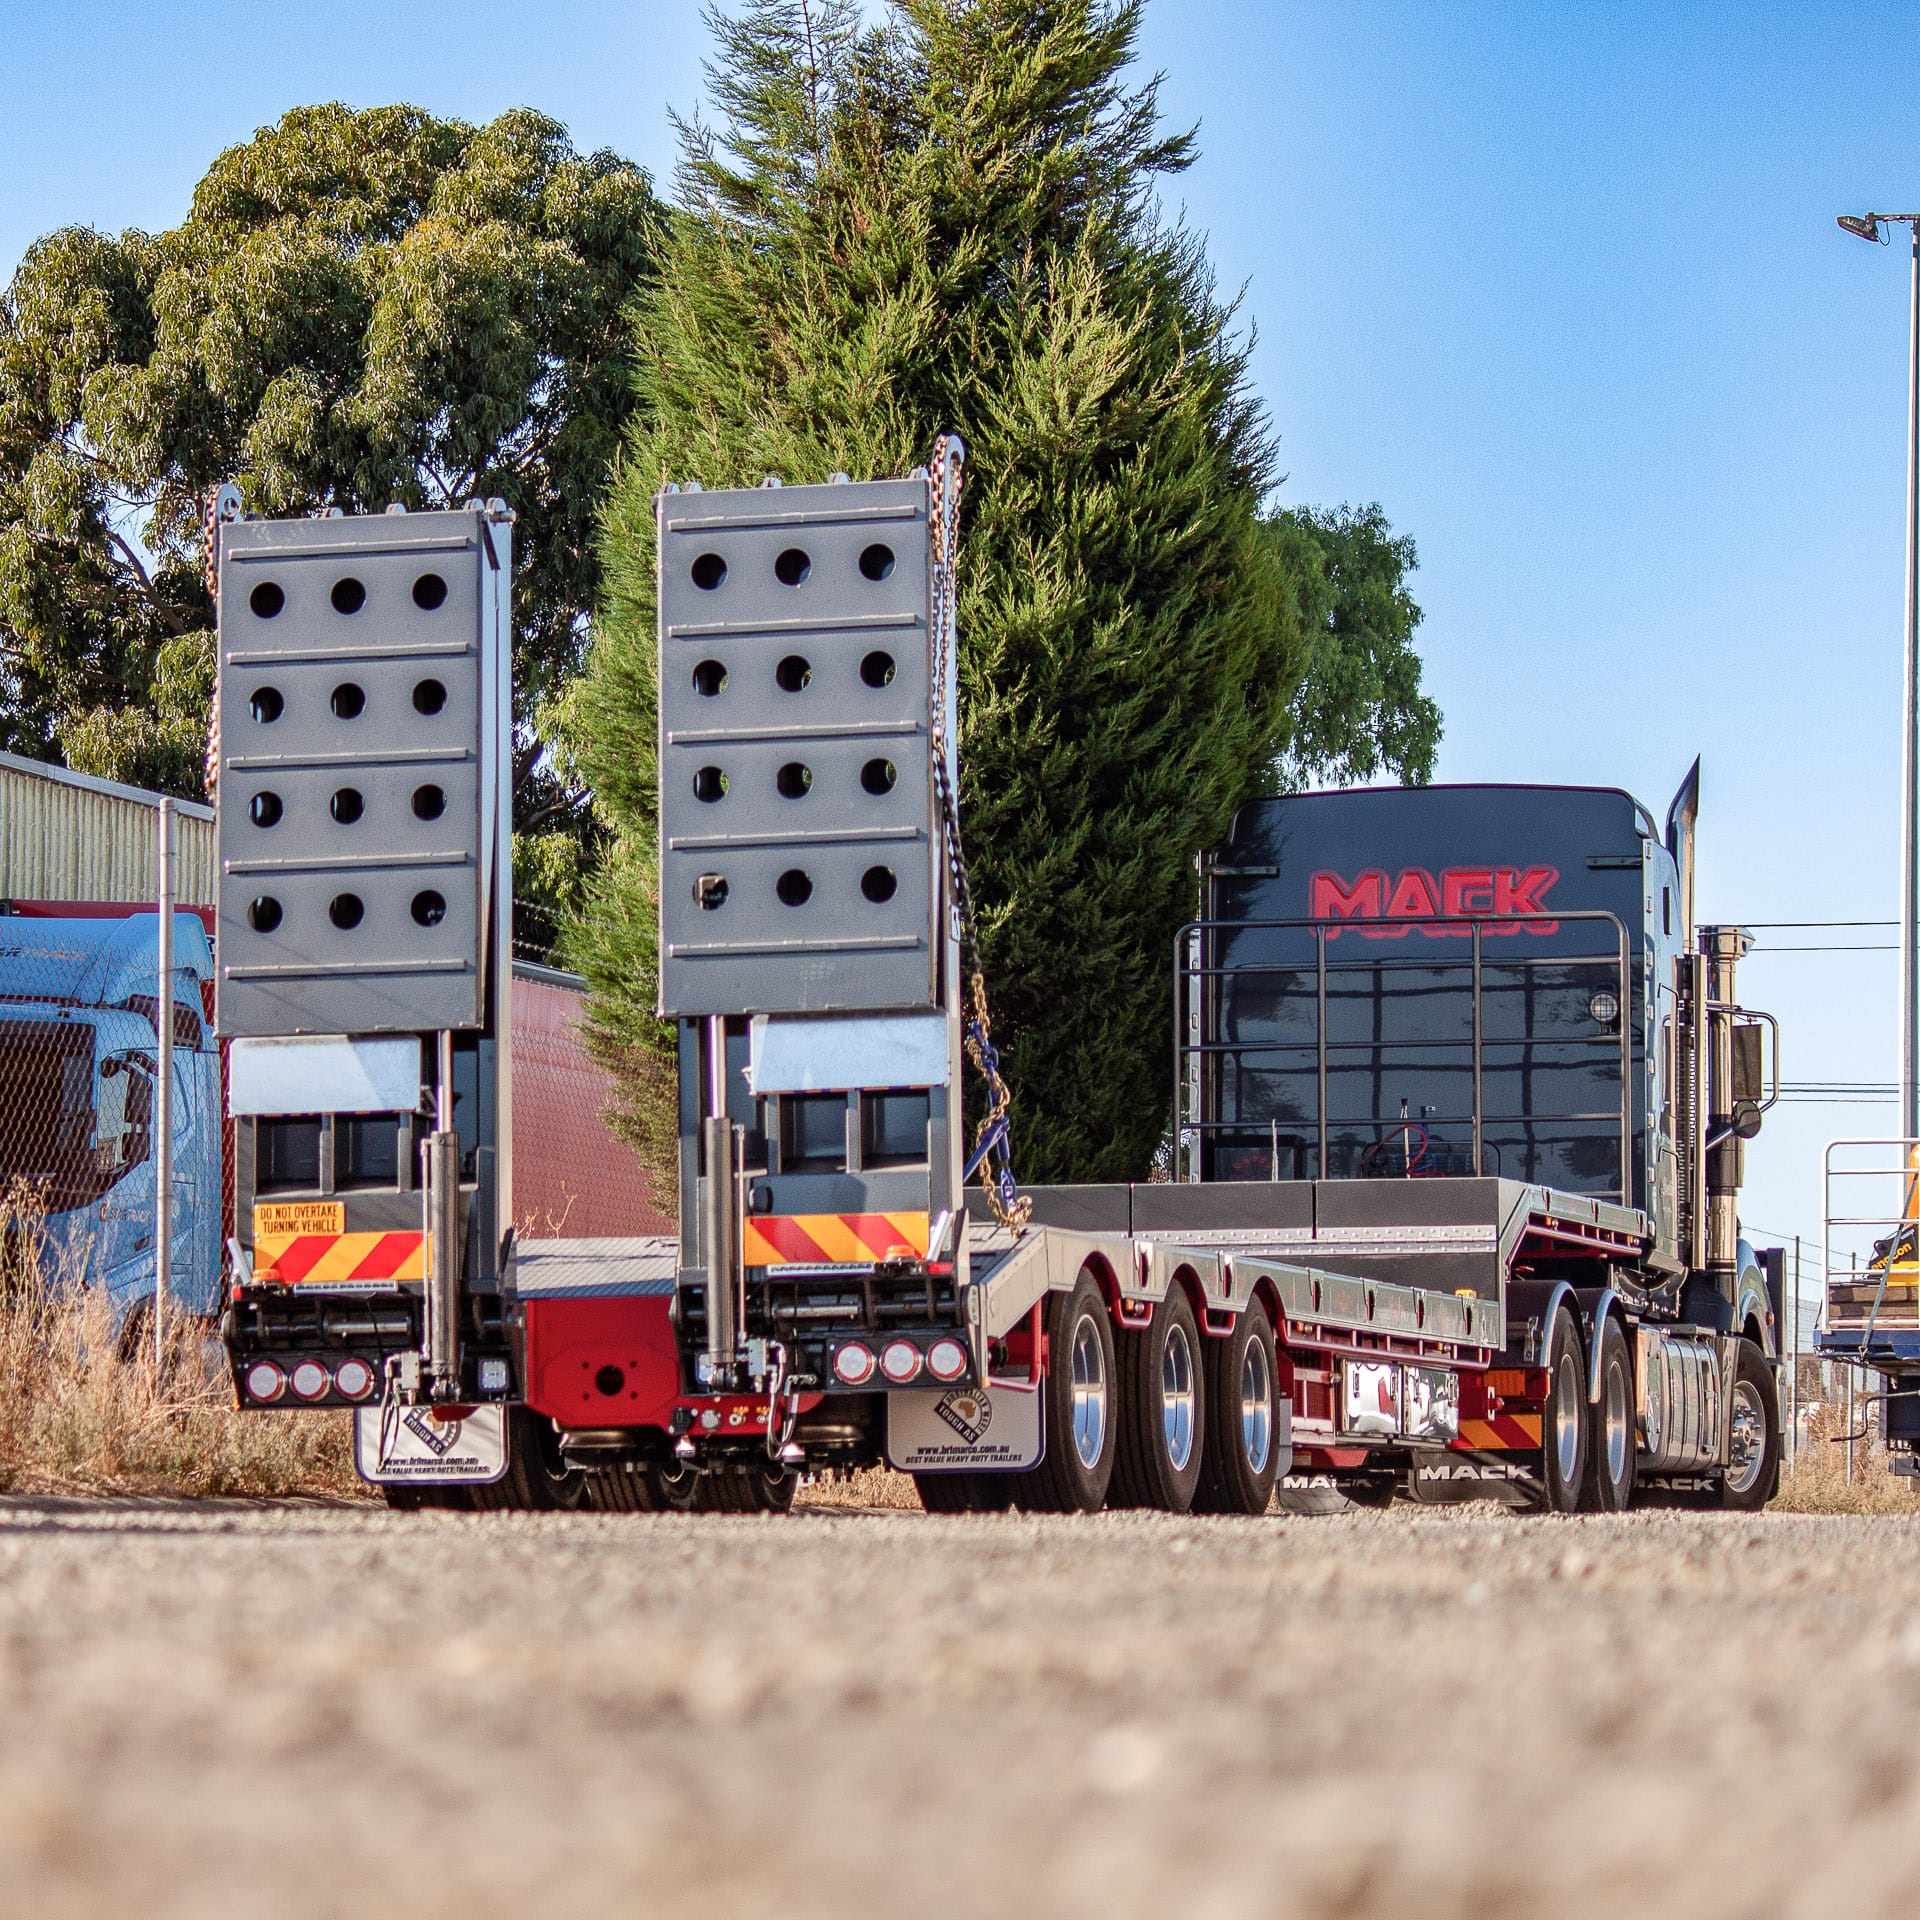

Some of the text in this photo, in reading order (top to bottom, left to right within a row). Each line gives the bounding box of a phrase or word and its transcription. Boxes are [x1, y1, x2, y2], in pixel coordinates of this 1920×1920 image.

[1309, 865, 1559, 938] MACK
[260, 1205, 338, 1220] DO NOT OVERTAKE
[263, 1219, 337, 1233] TURNING VEHICLE
[938, 1404, 976, 1441] TOUGH AS
[406, 1416, 432, 1442] TOUGH
[429, 1439, 442, 1452] AS
[917, 1444, 1010, 1455] www.brimarco.com.au
[905, 1454, 1023, 1464] BEST VALUE HEAVY DUTY TRAILERS
[1419, 1465, 1533, 1479] MACK
